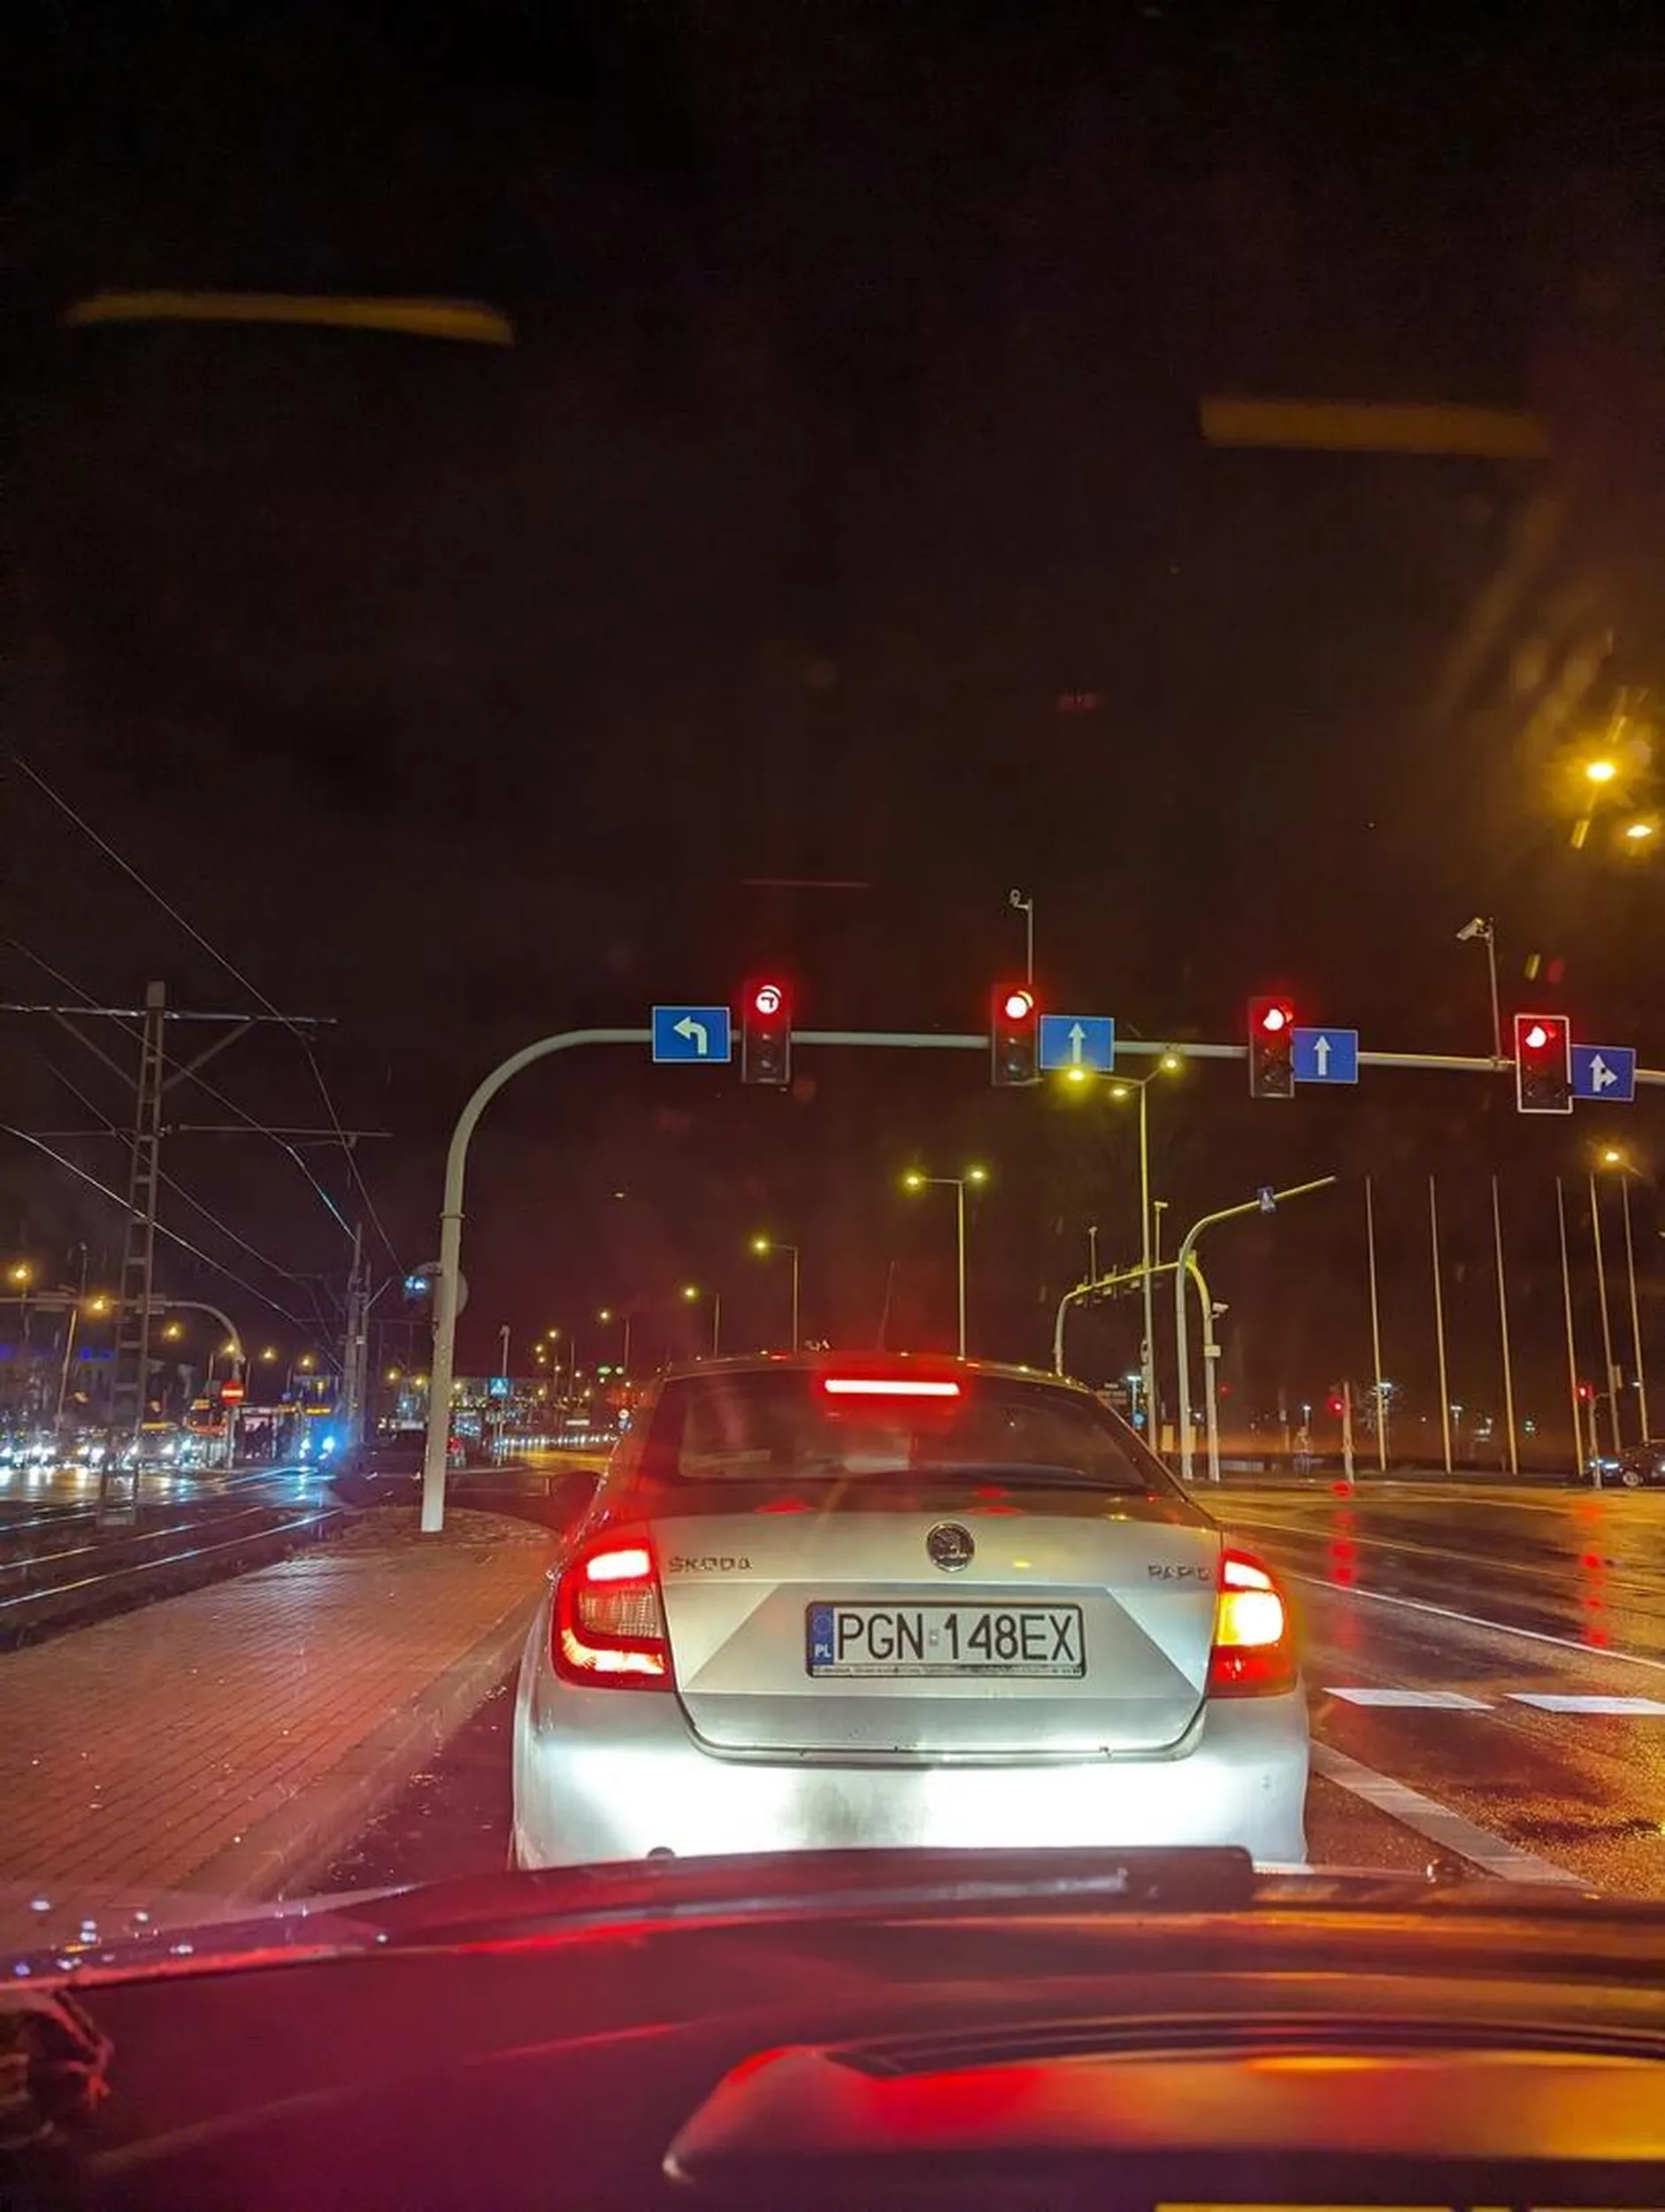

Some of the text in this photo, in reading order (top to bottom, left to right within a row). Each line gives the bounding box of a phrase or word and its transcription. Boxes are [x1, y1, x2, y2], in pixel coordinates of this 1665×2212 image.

[814, 1643, 832, 1658] PL
[837, 1613, 1076, 1662] PGN 148EX
